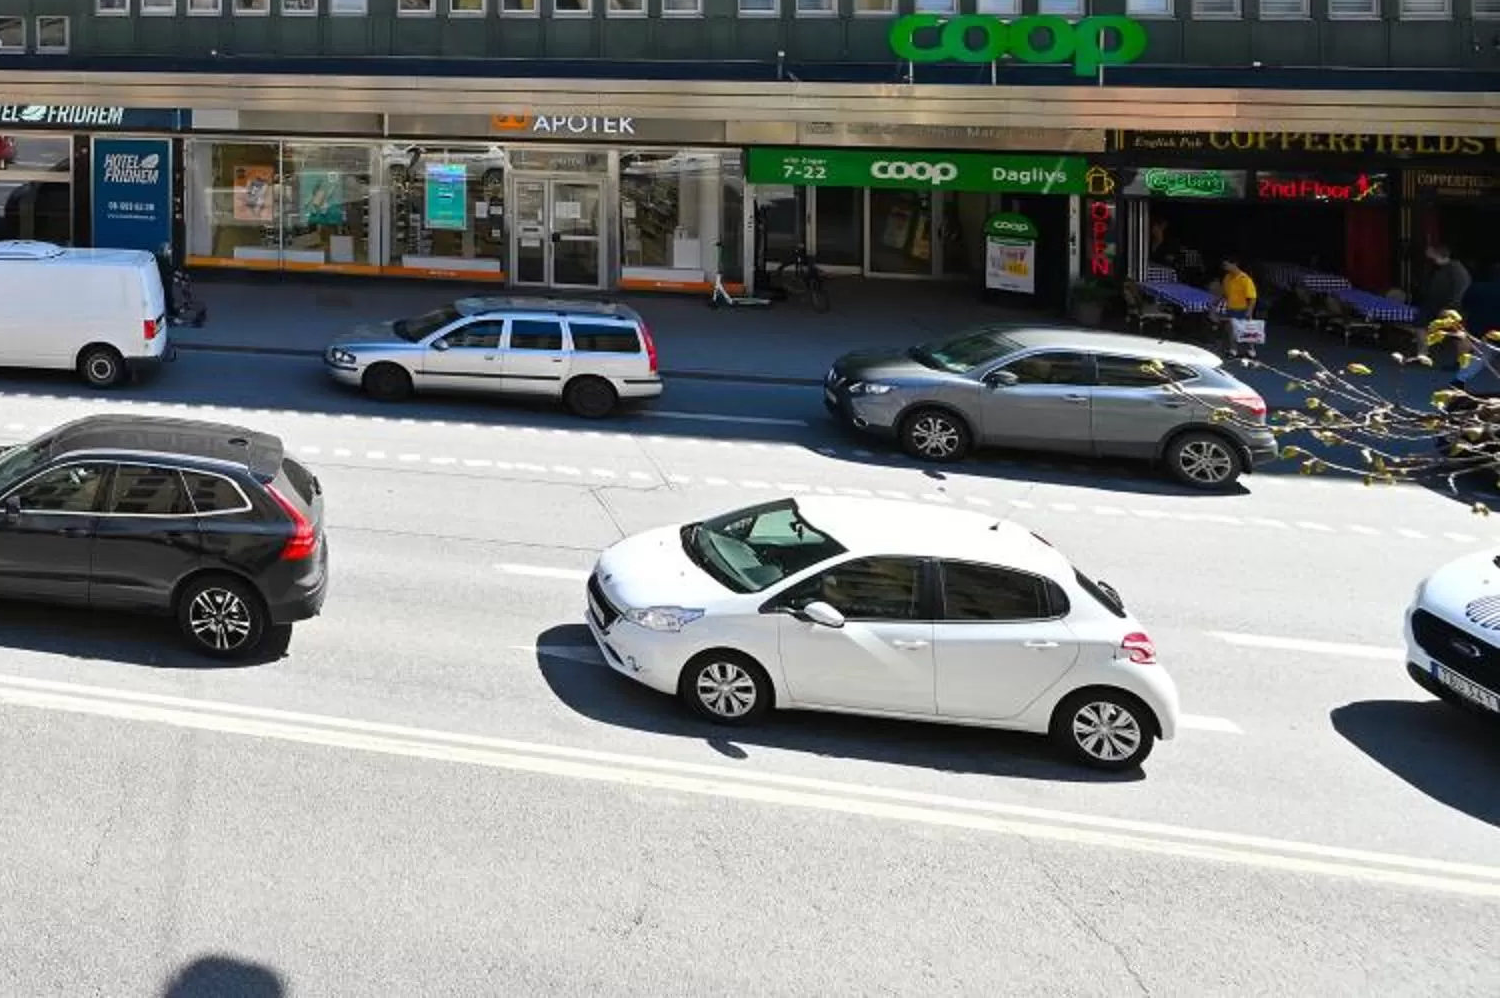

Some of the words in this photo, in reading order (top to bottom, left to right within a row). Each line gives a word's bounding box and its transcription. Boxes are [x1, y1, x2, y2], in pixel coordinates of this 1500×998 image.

[890, 14, 1147, 76] coop
[47, 106, 124, 125] FRIDHEM
[533, 114, 636, 135] APOTEK
[783, 165, 828, 179] 7-22
[870, 161, 958, 184] coop
[1259, 178, 1298, 199] 2nd
[1300, 179, 1351, 199] Floor
[993, 221, 1029, 232] coop
